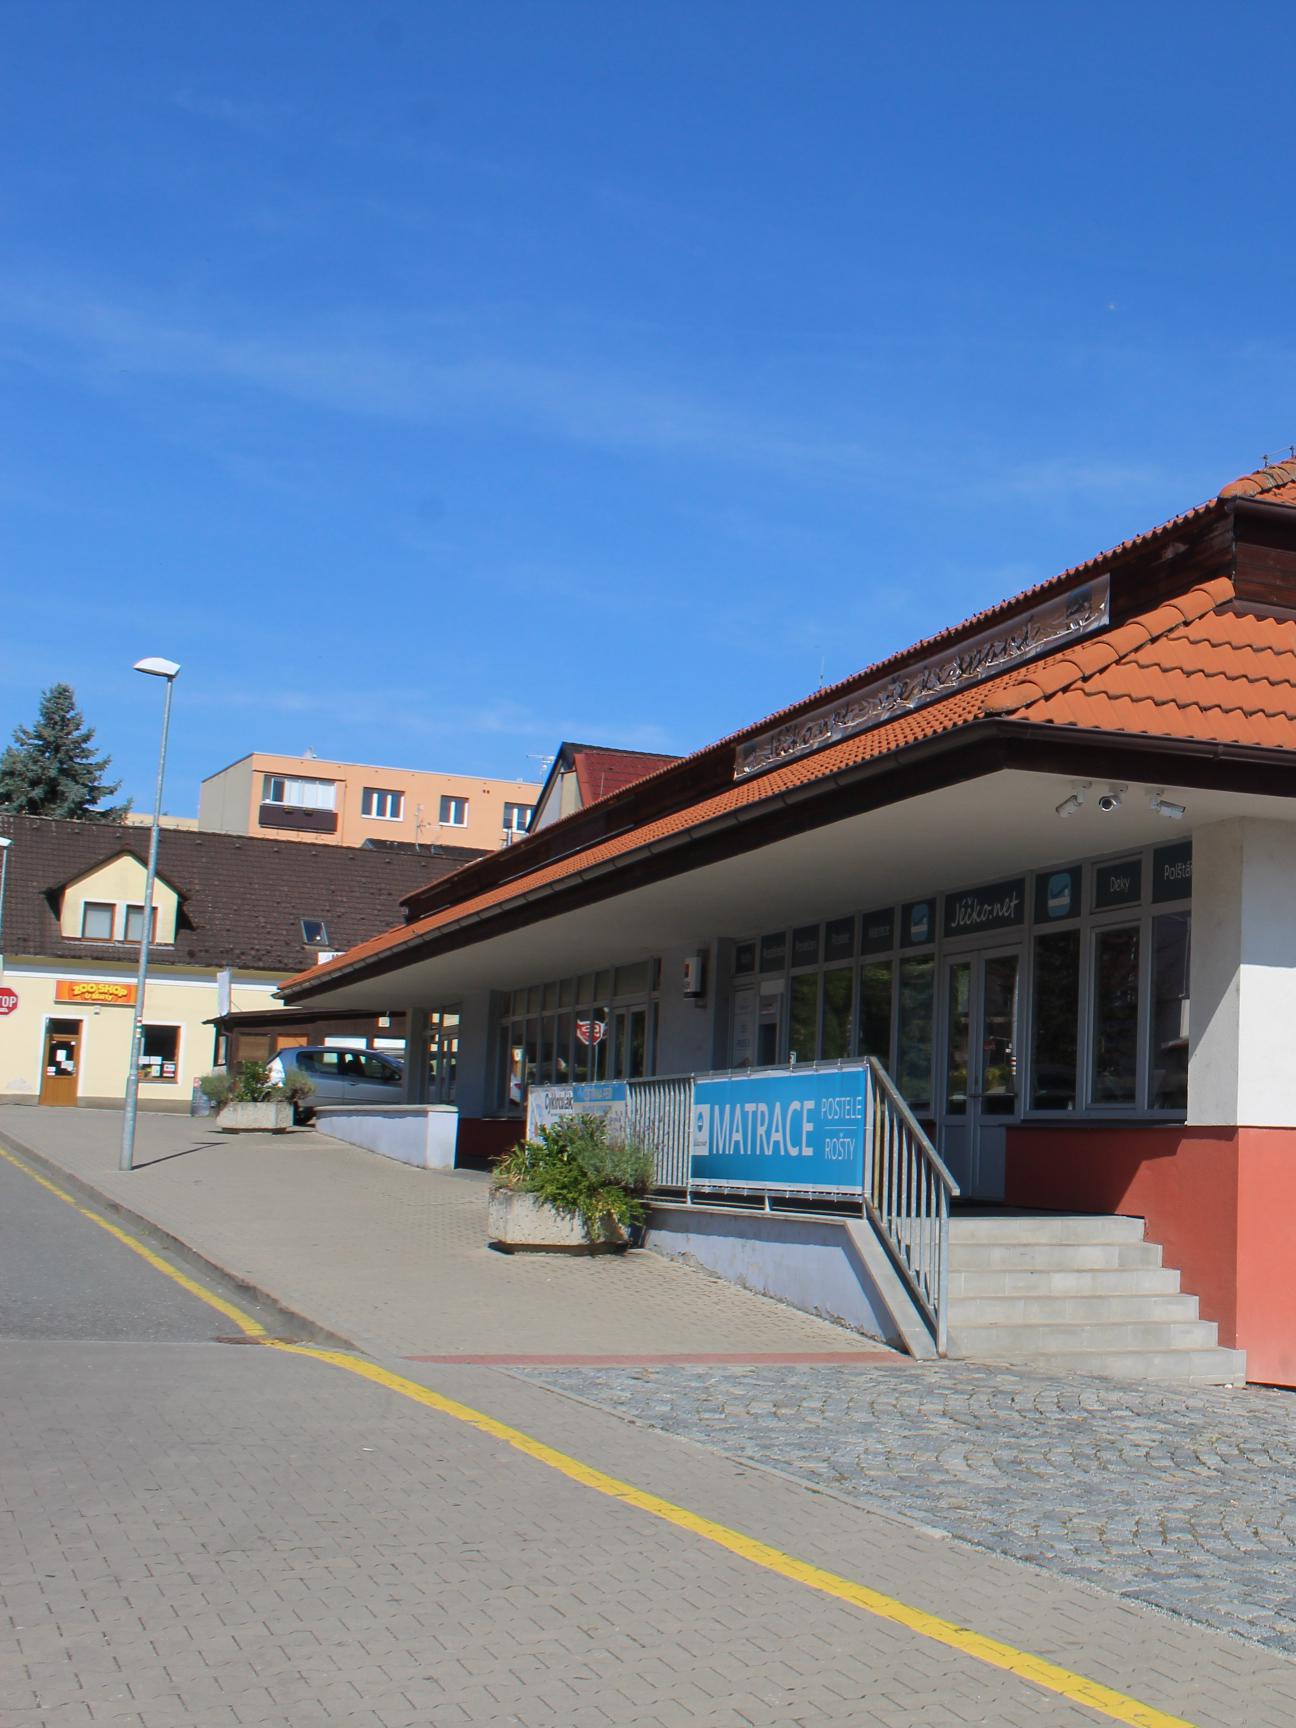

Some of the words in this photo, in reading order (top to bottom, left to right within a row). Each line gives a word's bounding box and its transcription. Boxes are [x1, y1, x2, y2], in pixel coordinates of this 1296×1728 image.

[1110, 876, 1130, 892] Deky
[951, 890, 1020, 927] Jéčko.net
[73, 983, 96, 995] ZOO
[98, 984, 128, 998] SHOP
[821, 1096, 862, 1121] POSTELE
[713, 1100, 815, 1157] MATRACE
[825, 1132, 856, 1160] ROŠTY
